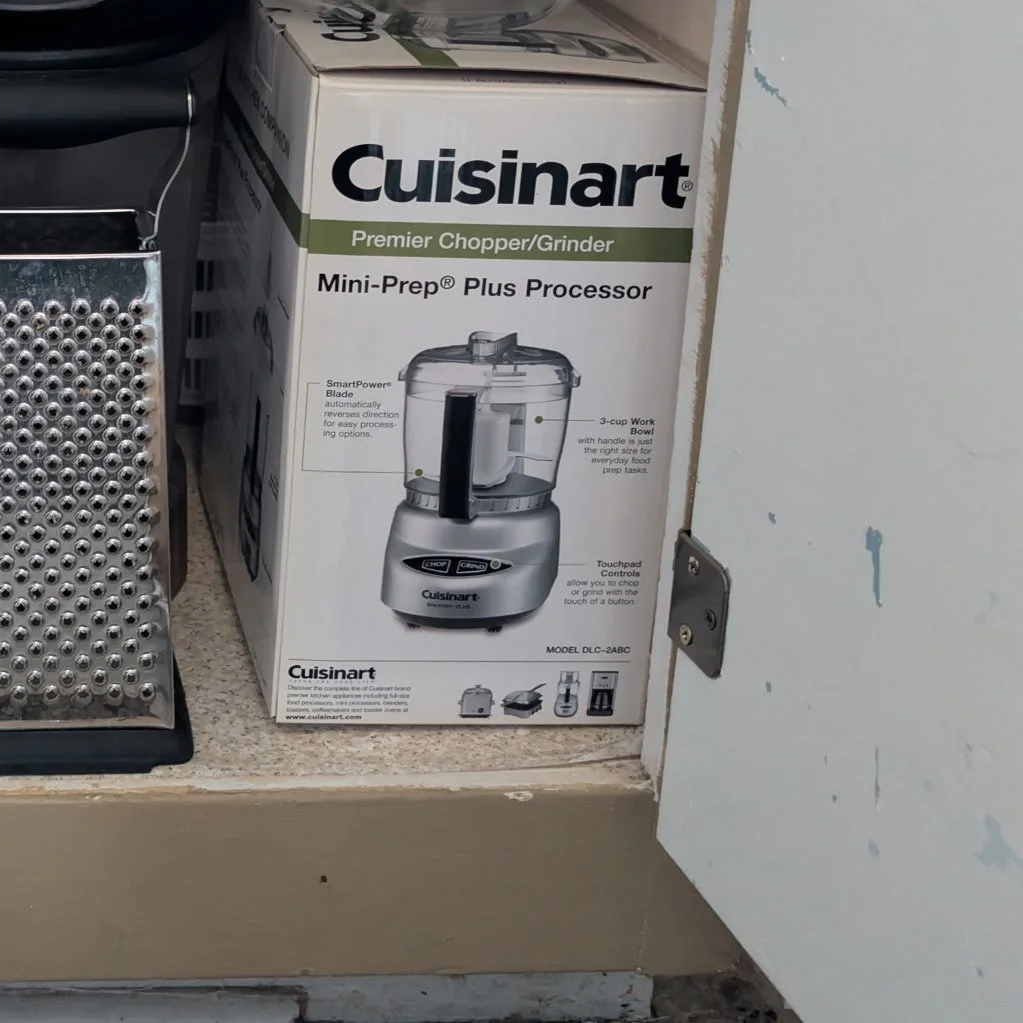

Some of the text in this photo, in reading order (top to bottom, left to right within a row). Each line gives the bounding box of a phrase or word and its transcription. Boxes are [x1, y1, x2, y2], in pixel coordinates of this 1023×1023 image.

[351, 231, 615, 254] Premier Chopper/Grinder
[463, 278, 517, 298] Plus
[526, 279, 653, 300] Processor
[326, 389, 354, 398] Blade
[324, 400, 382, 410] automatically
[324, 410, 400, 419] reverses direction
[323, 419, 335, 427] for
[337, 421, 358, 429] easy
[599, 417, 656, 427] 3-cup Work
[322, 430, 336, 439] ing
[630, 427, 655, 435] Bowl
[577, 437, 653, 446] with handle is just
[599, 447, 619, 456] right
[621, 447, 638, 455] size
[640, 447, 652, 455] for
[591, 457, 629, 465] everyday
[602, 466, 622, 475] prep
[460, 562, 486, 570] GRIND
[597, 560, 642, 569] Touchpad
[566, 579, 588, 587] allow
[590, 580, 606, 588] you
[618, 580, 640, 588] chop
[582, 589, 603, 597] grind
[545, 646, 580, 654] MODEL
[287, 664, 376, 680] Cuisinart
